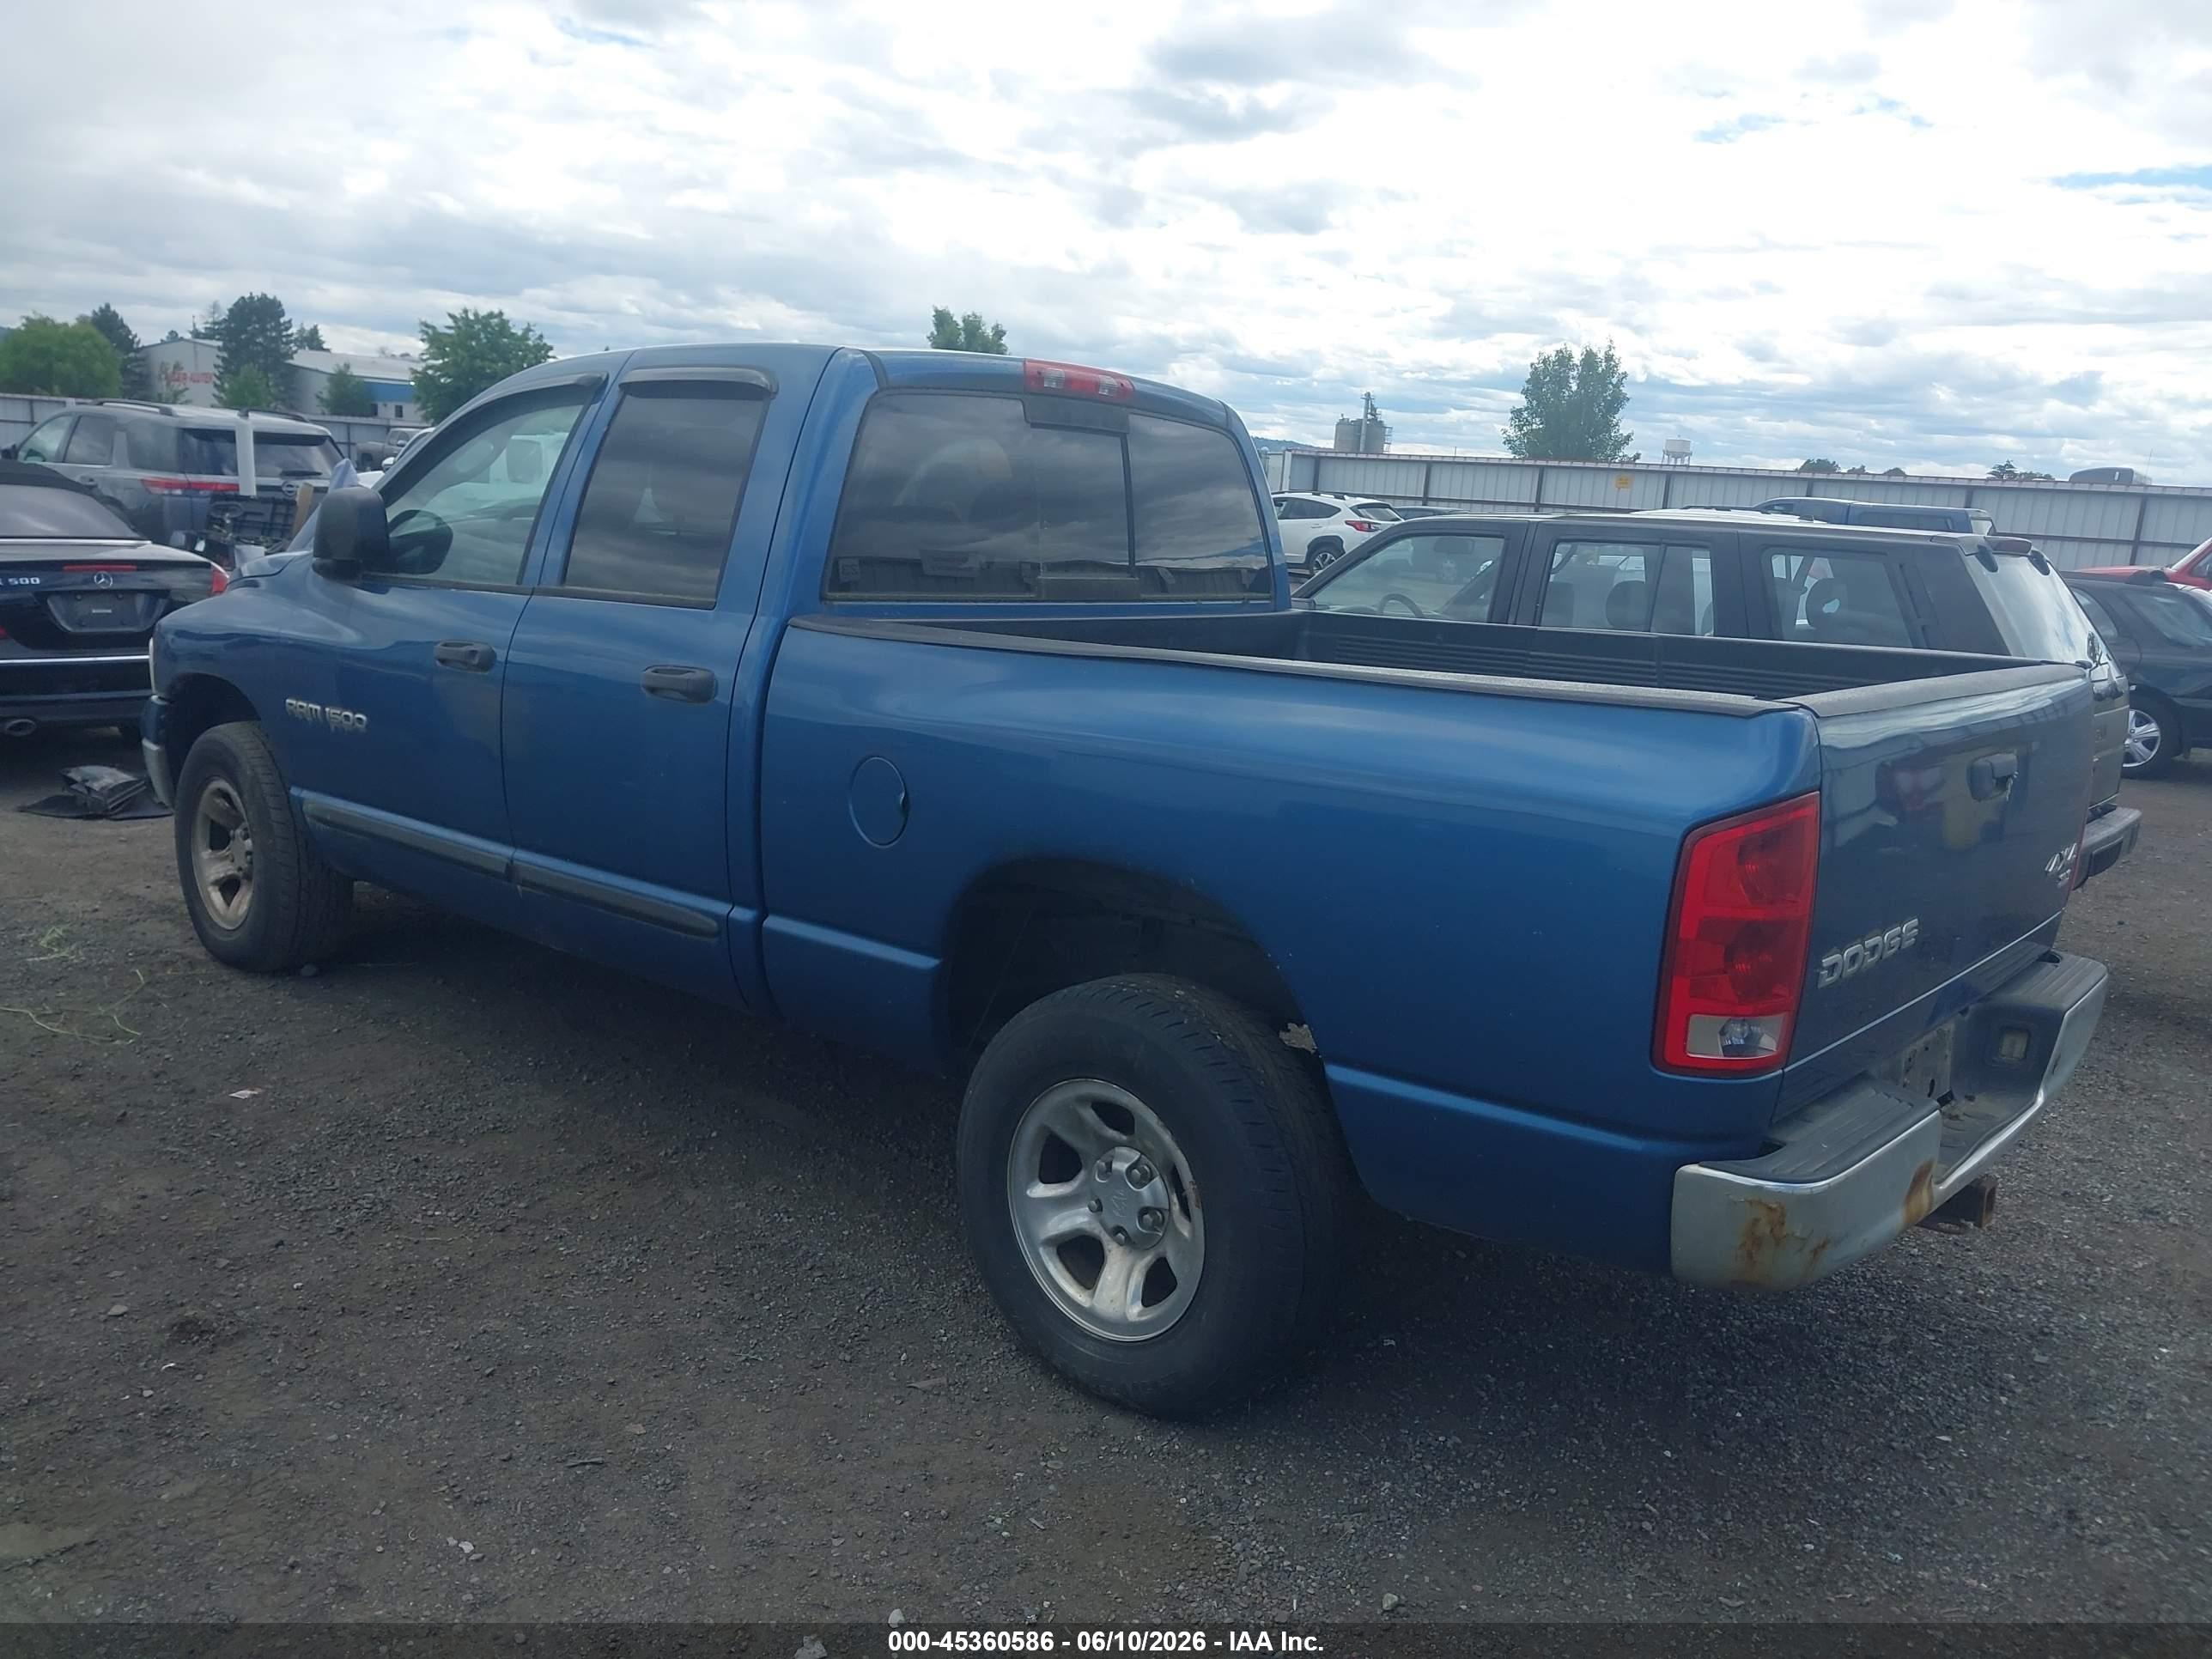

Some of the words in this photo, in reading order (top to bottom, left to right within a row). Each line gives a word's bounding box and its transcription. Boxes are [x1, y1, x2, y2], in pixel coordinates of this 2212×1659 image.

[8, 576, 40, 585] 500
[285, 698, 322, 721] RAM
[325, 707, 368, 729] 1500
[1818, 919, 1919, 989] DODGE
